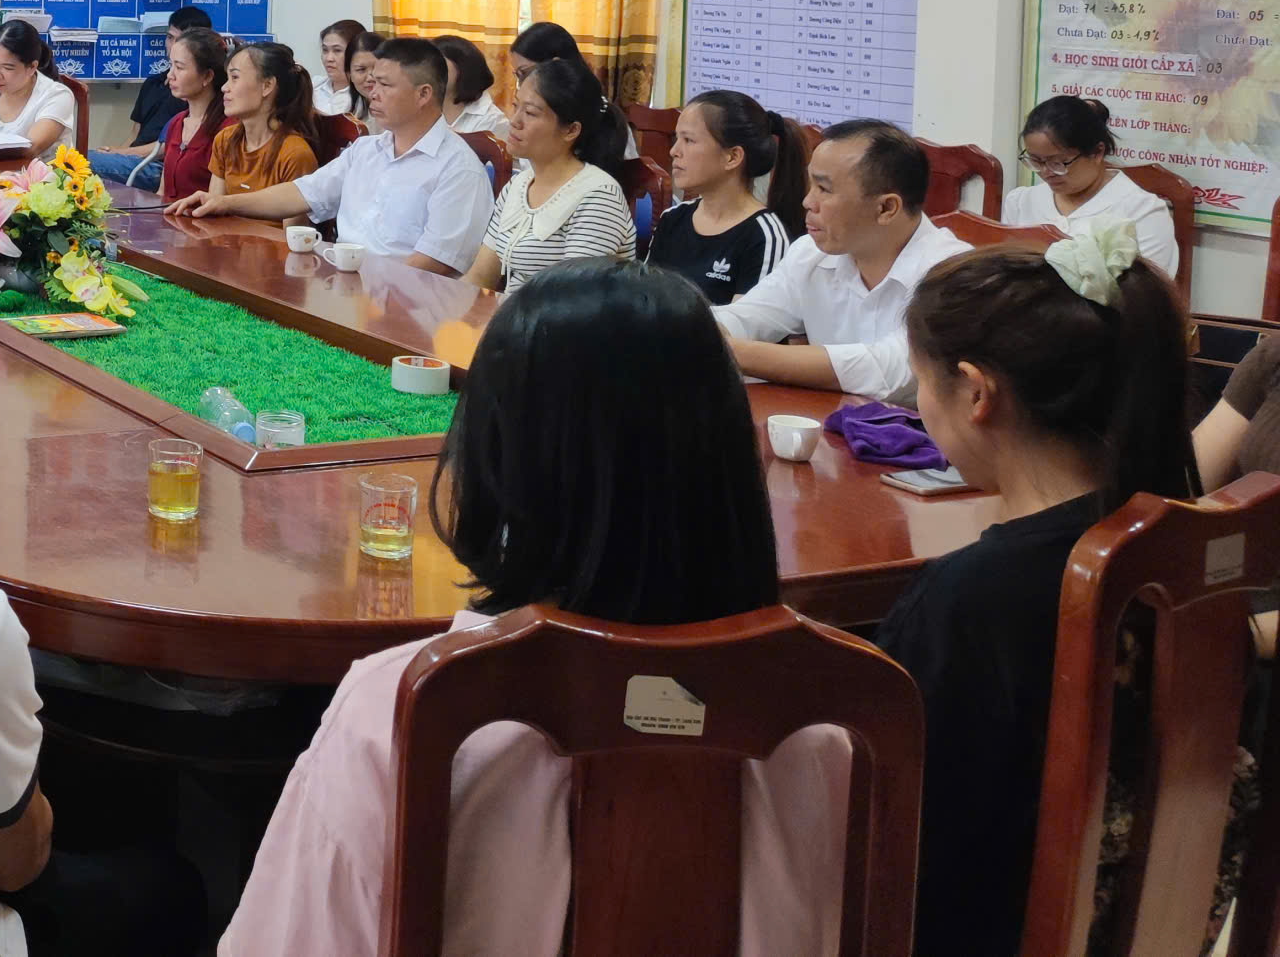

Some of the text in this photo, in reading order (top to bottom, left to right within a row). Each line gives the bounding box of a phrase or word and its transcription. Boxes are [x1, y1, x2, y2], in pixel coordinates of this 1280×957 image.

[1249, 10, 1264, 21] 05
[1057, 27, 1083, 38] Chưa
[1111, 30, 1124, 40] 03
[1065, 54, 1088, 67] HỌC
[1091, 56, 1118, 68] SINH
[1151, 54, 1174, 71] CẤP
[1206, 62, 1223, 74] 03
[1106, 88, 1131, 99] CUỘC
[1135, 91, 1152, 101] THI
[1193, 95, 1208, 105] 09
[1131, 119, 1150, 130] LỚP
[1138, 150, 1269, 175] CÔNG NHẬN TỐT NGHIỆP:
[705, 271, 731, 282] adidas
